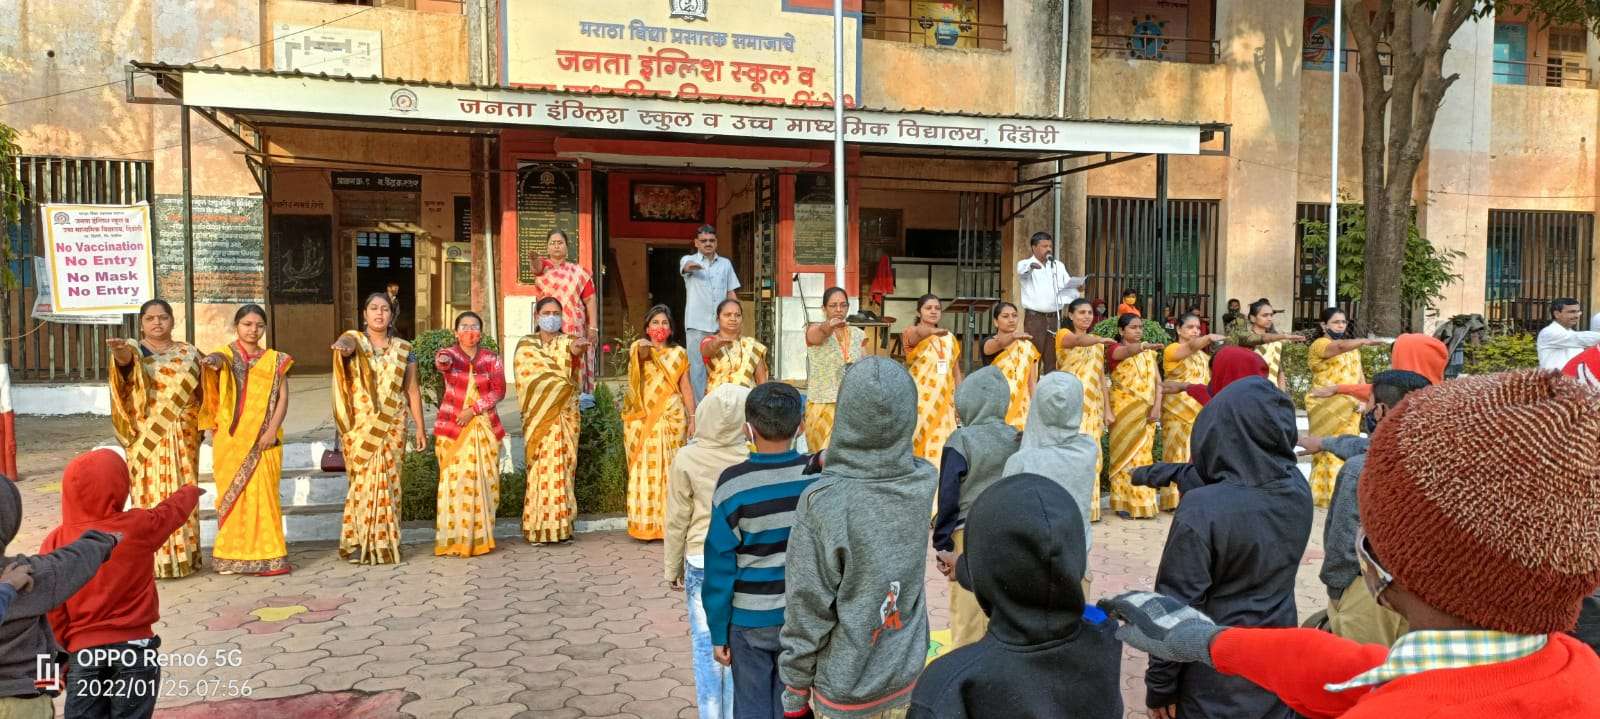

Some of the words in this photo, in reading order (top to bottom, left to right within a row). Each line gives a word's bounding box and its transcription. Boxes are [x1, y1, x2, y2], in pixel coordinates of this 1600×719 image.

[579, 21, 625, 40] मराठा
[628, 19, 667, 42] विद्या
[671, 28, 728, 47] प्रसारक
[731, 32, 796, 52] समाजाचे
[556, 49, 631, 75] जनता
[639, 47, 725, 82] इंग्लिश
[730, 61, 791, 93] स्कूल
[797, 66, 816, 87] व
[458, 98, 537, 118] जनता
[546, 100, 629, 123] इंग्लिश
[702, 113, 723, 128] व
[731, 115, 778, 132] उच्च
[786, 116, 890, 136] माध्यमिक
[897, 119, 989, 144] विद्यालय,
[999, 123, 1060, 145] दिंडोरी
[56, 242, 72, 252] No
[75, 241, 144, 252] Vaccination
[65, 256, 88, 266] No
[93, 255, 137, 267] Entry
[67, 272, 90, 283] No
[95, 271, 138, 282] Mask
[68, 286, 91, 297] No
[96, 286, 140, 296] Entry
